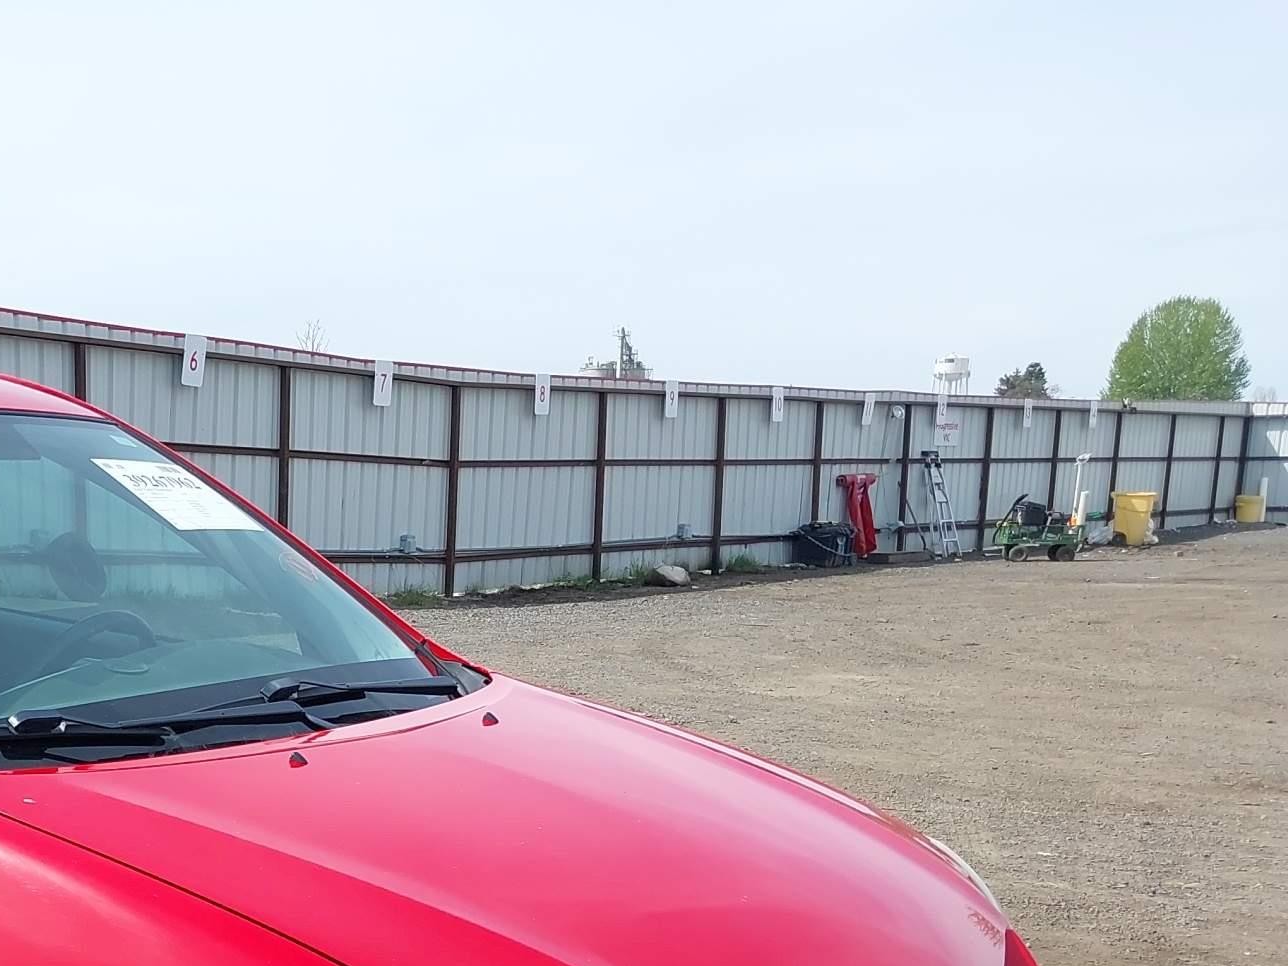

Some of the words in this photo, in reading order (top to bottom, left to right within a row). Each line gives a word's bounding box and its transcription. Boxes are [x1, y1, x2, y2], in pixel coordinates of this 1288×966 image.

[189, 350, 198, 371] 6
[380, 373, 387, 393] 7
[539, 385, 545, 403] 8
[669, 390, 675, 406] 9
[774, 396, 782, 411] 10
[122, 474, 202, 490] 39267962
